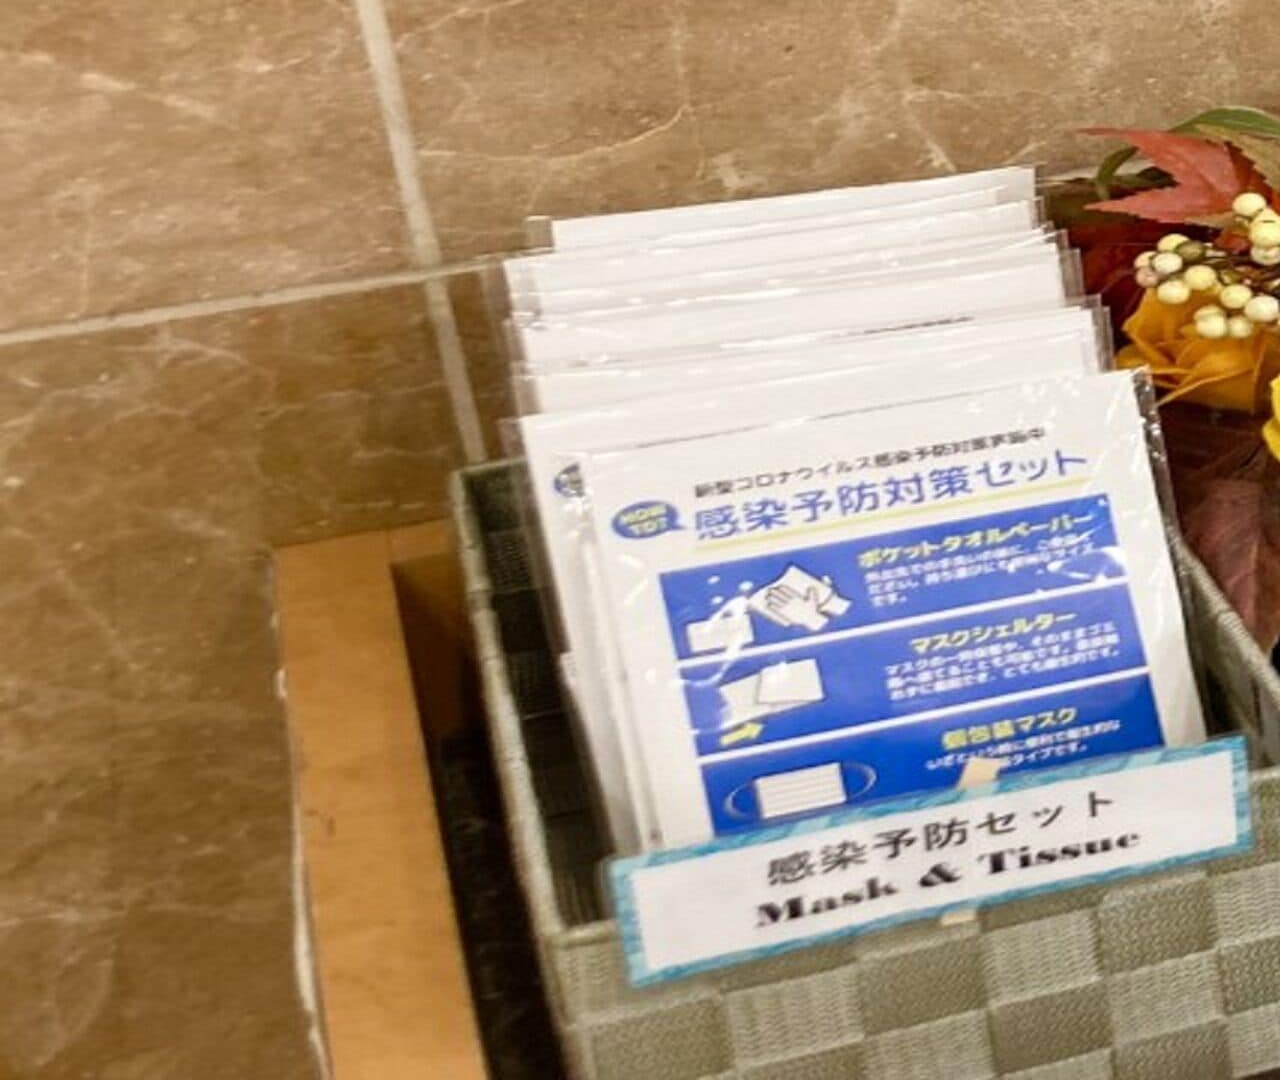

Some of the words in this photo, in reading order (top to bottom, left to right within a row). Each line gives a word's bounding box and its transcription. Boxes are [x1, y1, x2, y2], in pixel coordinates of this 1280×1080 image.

[695, 448, 1088, 541] 感染予防対策セット
[858, 513, 1094, 568] ポケットタオルペーパー
[909, 612, 1078, 654] マスクシェルター
[755, 877, 900, 929] Mask
[919, 862, 962, 889] &
[976, 831, 1142, 876] Tissue
[766, 790, 1114, 887] 感染予防セット
